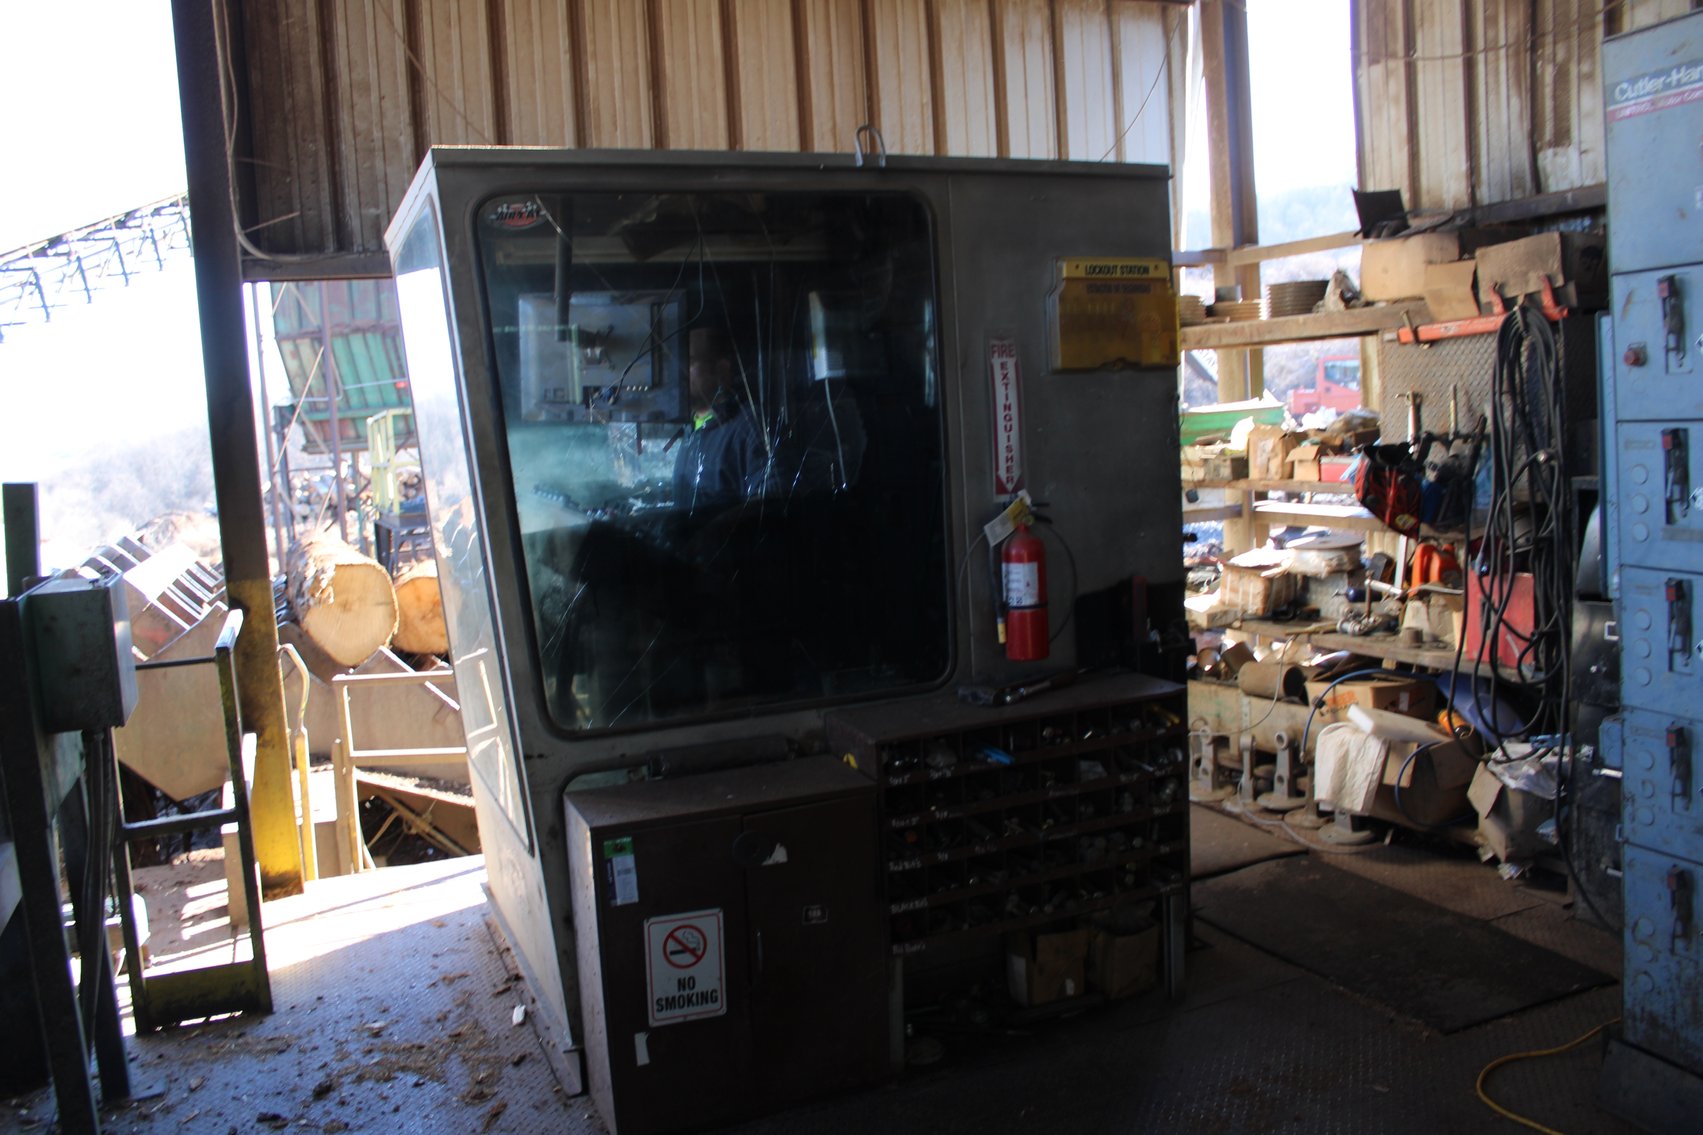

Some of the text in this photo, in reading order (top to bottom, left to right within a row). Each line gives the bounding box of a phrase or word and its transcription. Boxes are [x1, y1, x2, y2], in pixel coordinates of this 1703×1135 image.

[1085, 263, 1150, 275] LOCKOUT STATION
[991, 344, 1016, 359] FIRE
[1000, 361, 1014, 485] EXTINGUISHER
[677, 975, 696, 993] NO
[656, 989, 719, 1013] SMOKING
